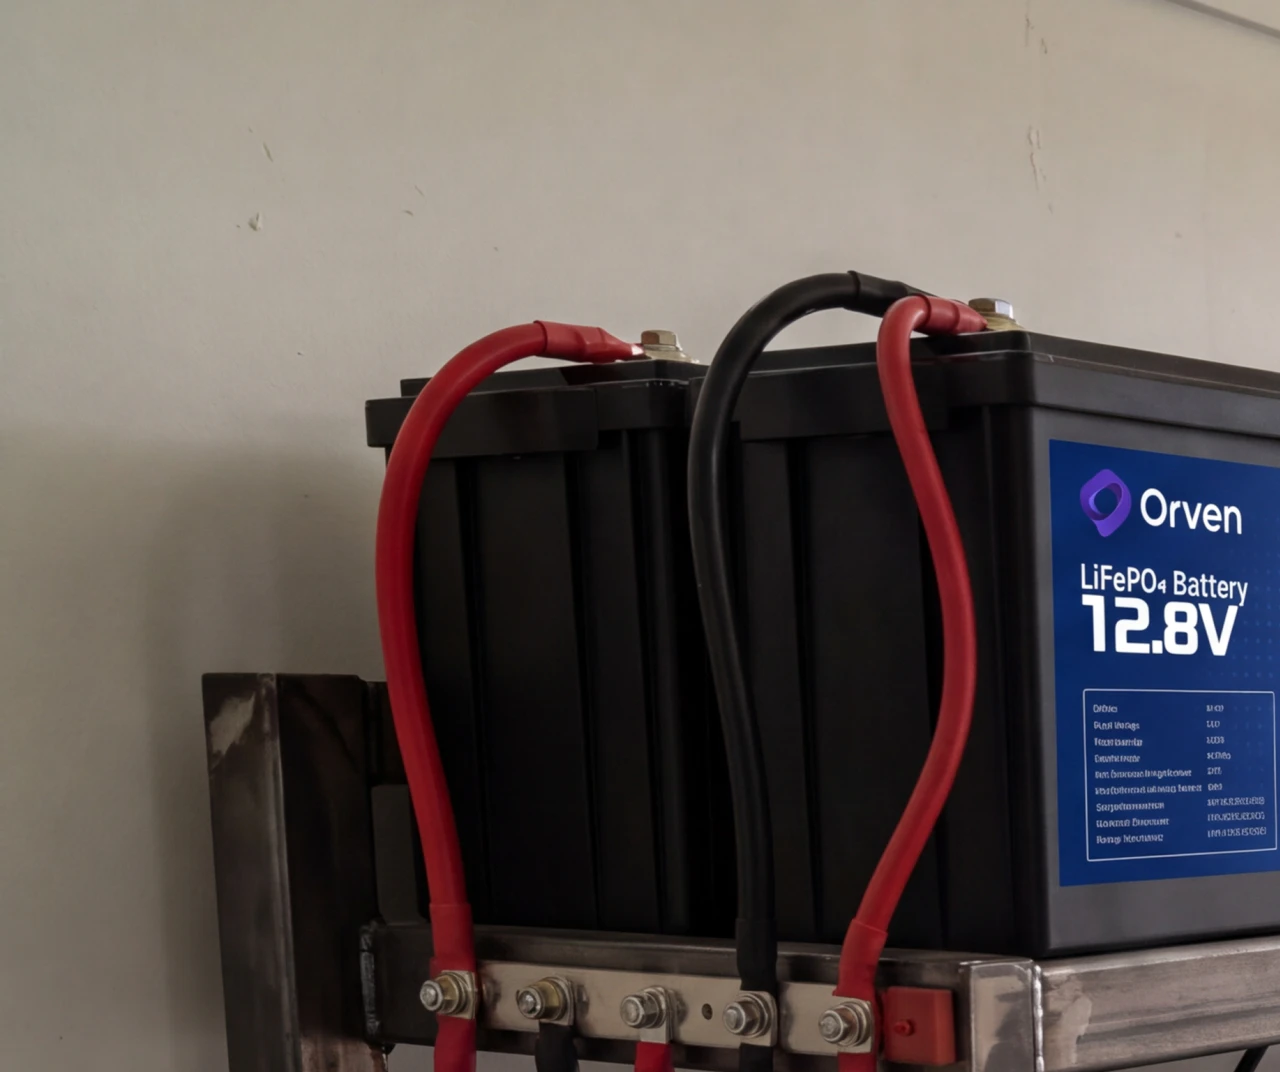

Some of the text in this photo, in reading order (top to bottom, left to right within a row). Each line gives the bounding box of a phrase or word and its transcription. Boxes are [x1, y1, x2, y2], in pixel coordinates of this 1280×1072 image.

[1140, 488, 1242, 535] Orven
[1173, 570, 1248, 607] Battery
[1081, 593, 1239, 657] 12.8V
